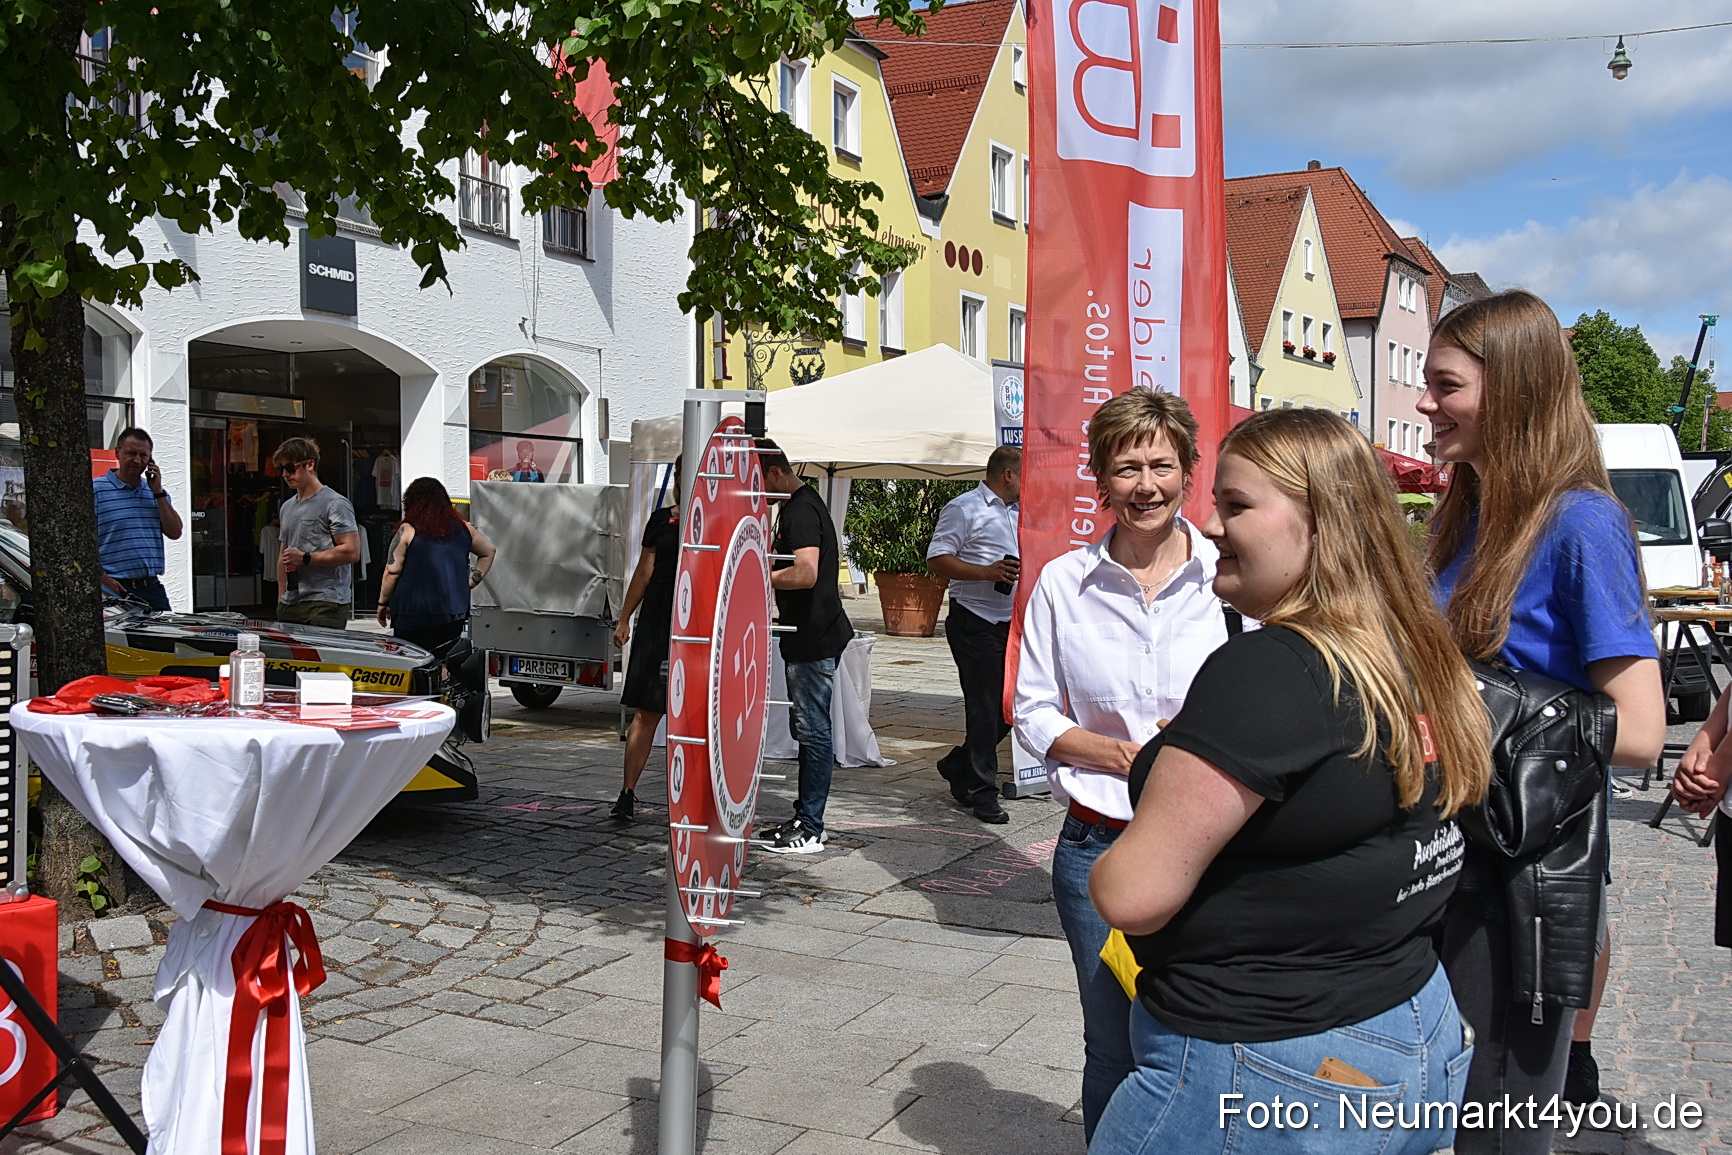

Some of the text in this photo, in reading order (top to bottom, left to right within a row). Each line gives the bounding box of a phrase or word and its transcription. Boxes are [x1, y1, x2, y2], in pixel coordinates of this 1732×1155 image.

[308, 262, 355, 283] SCHMID
[518, 659, 539, 674] PAR
[545, 662, 559, 675] GR
[561, 664, 568, 676] 1
[351, 668, 405, 687] Castrol
